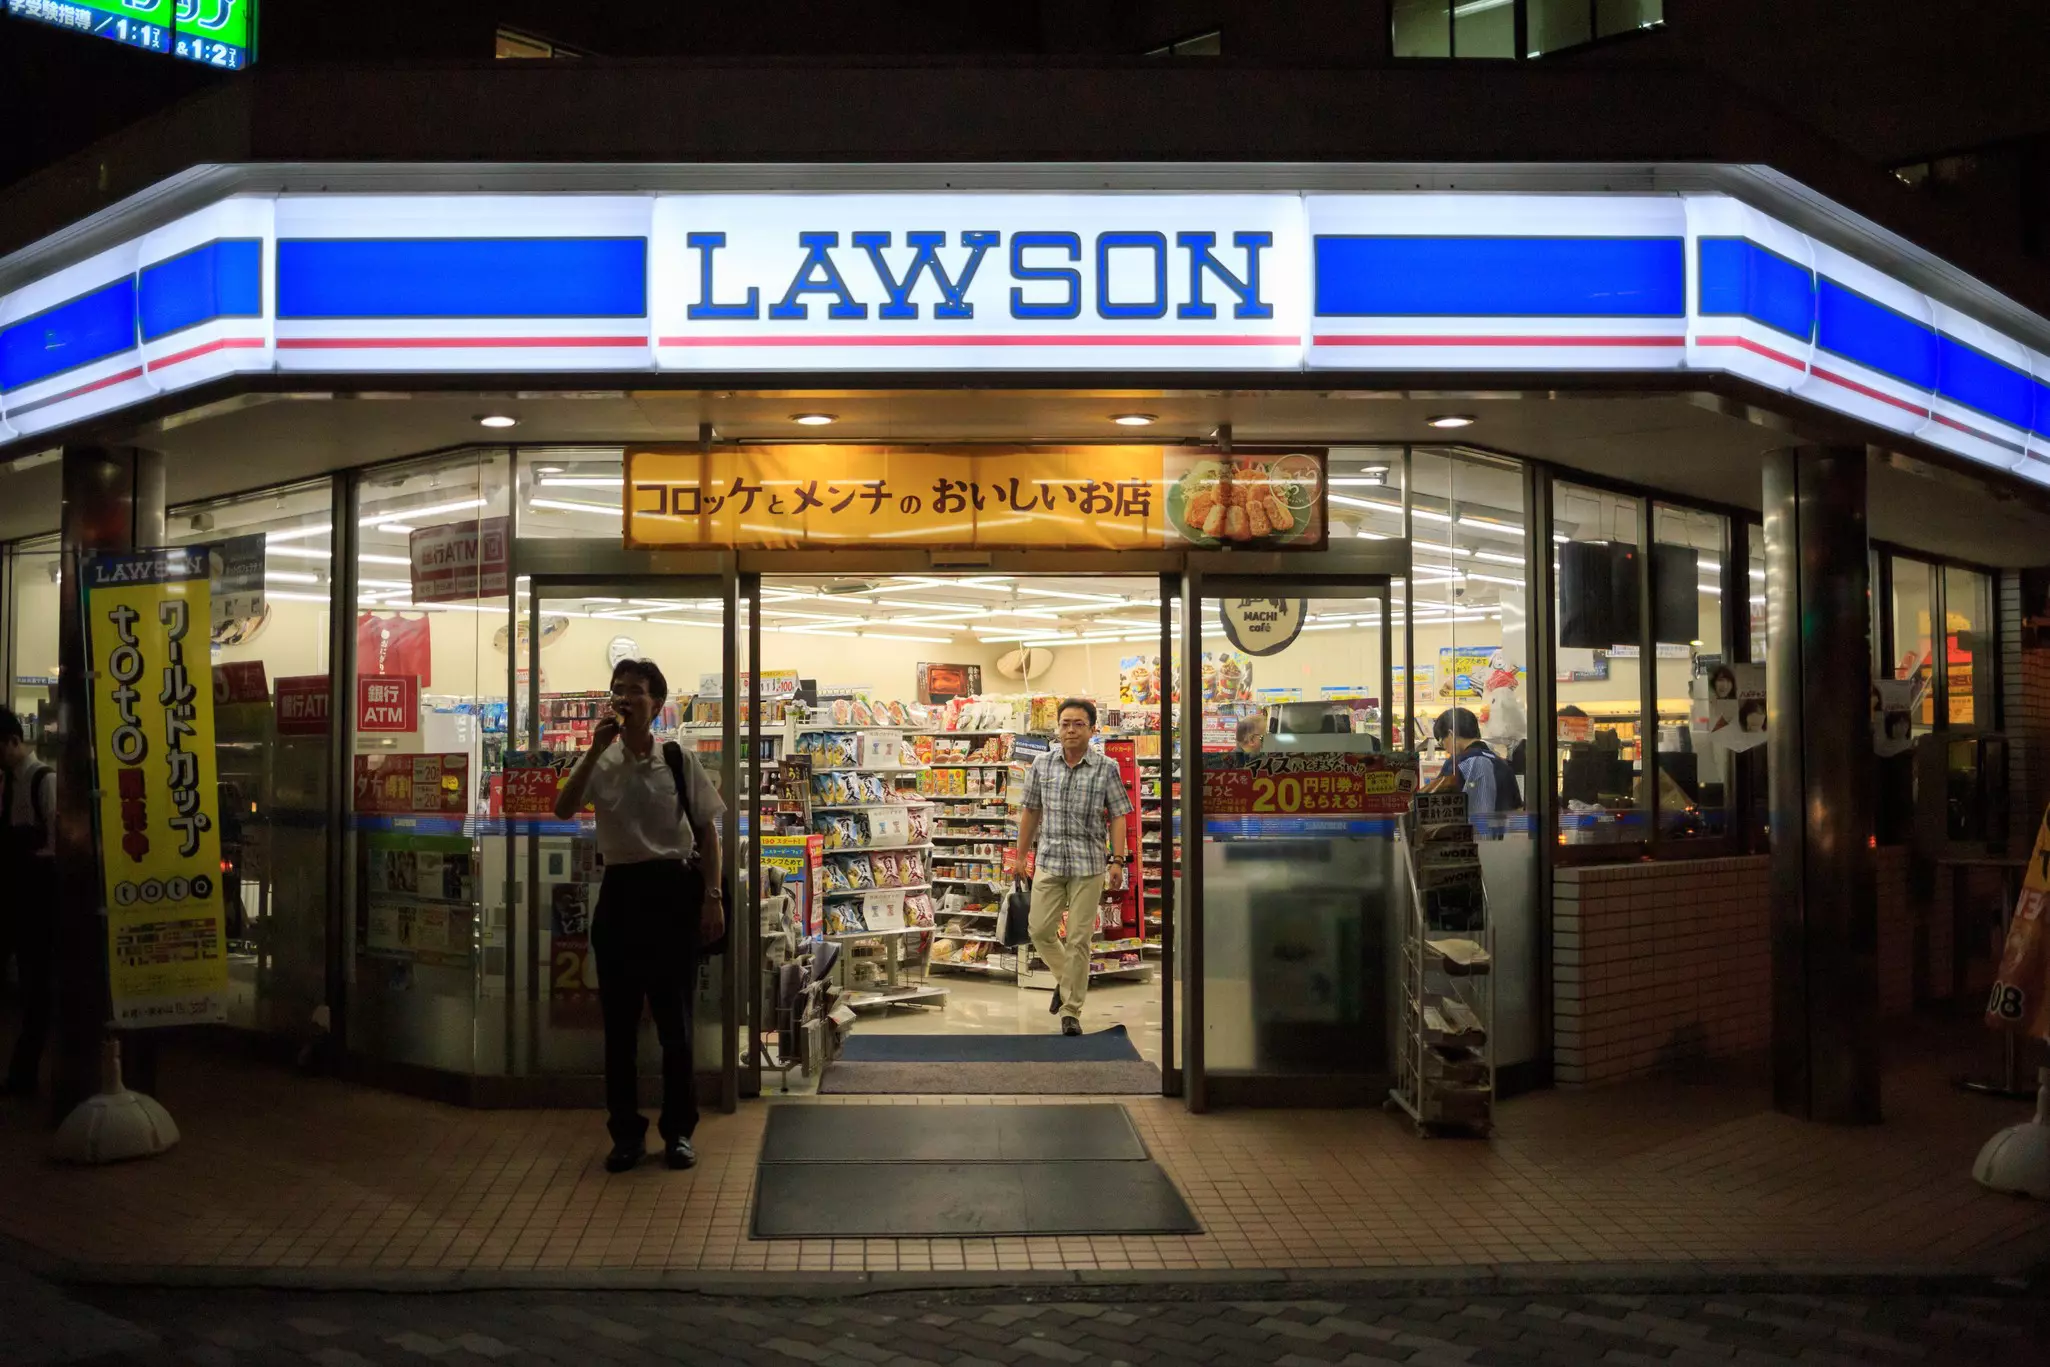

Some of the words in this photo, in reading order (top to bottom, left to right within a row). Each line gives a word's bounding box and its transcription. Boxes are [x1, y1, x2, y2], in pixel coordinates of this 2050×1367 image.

[687, 231, 1273, 320] LAWSON
[636, 477, 1152, 517] コロッケとメンチのおいしいお店
[1243, 611, 1278, 621] MACHI
[108, 604, 149, 766] toto
[367, 684, 400, 703] 銀行
[281, 692, 329, 718] 銀行AT
[364, 707, 403, 723] ATM
[158, 600, 211, 858] ワールドカップ
[506, 770, 552, 784] アイスを
[1203, 771, 1248, 785] アイスを
[1252, 777, 1301, 812] 20
[1430, 795, 1464, 807] 夫婦の
[1440, 848, 1478, 858] WORK
